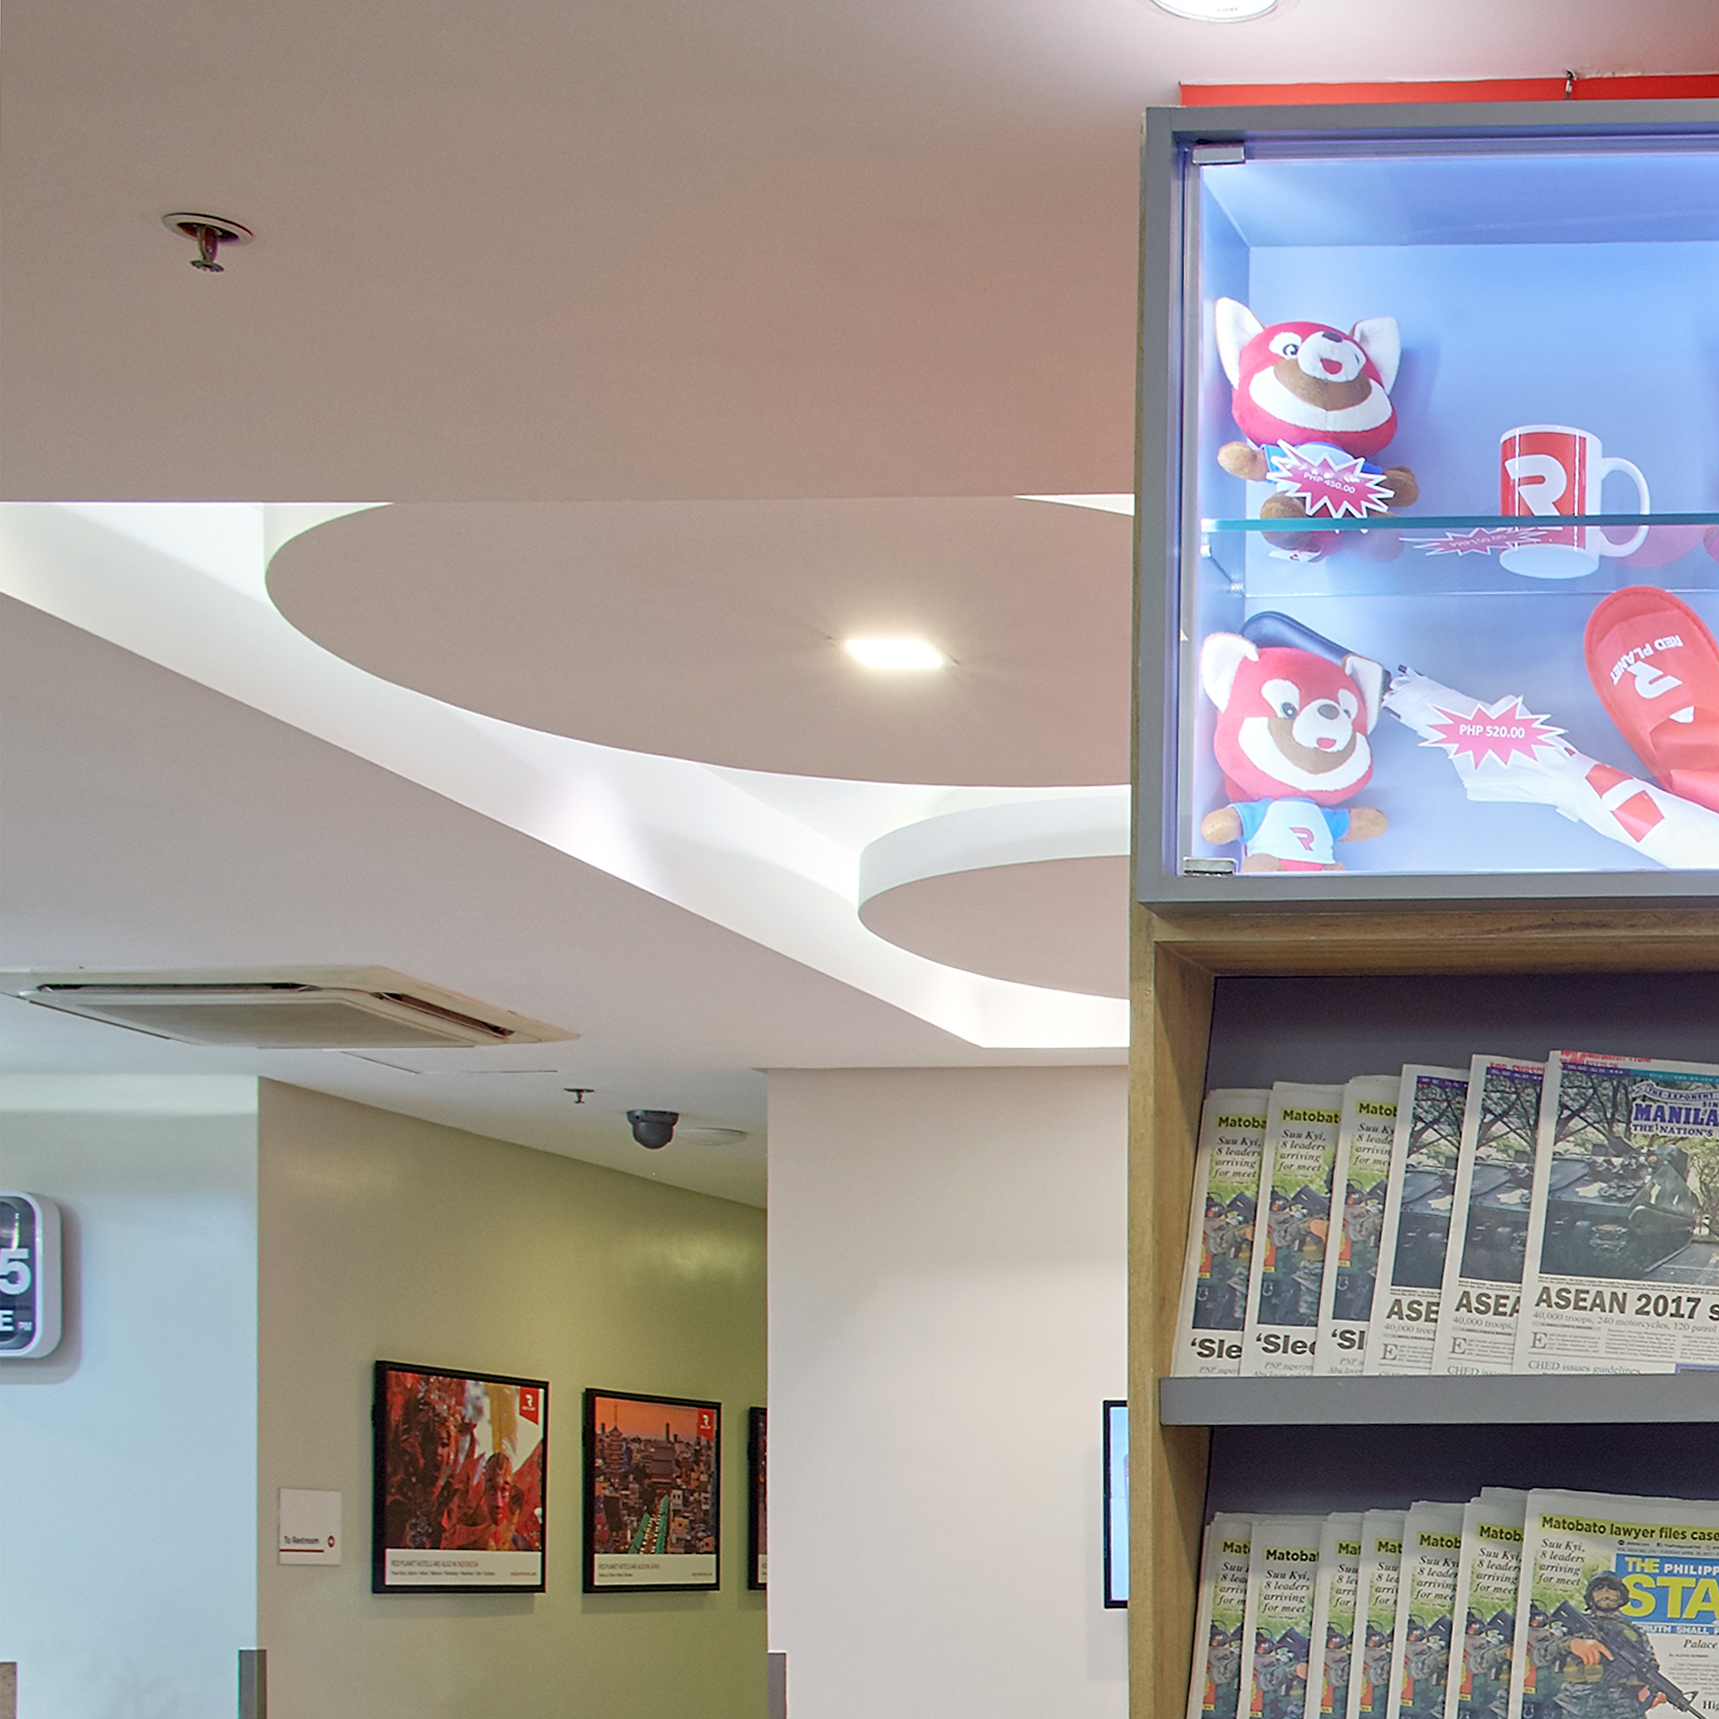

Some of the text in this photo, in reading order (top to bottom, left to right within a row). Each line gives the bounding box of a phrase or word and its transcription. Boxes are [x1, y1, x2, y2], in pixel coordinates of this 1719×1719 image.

[1459, 723, 1526, 740] PHP 520.00
[1534, 1286, 1628, 1314] ASEAN
[1634, 1293, 1702, 1319] 2017
[1541, 1516, 1606, 1535] Matobato
[1610, 1522, 1656, 1542] lawyer
[1659, 1525, 1687, 1540] files
[1625, 1556, 1660, 1573] THE
[1682, 1639, 1719, 1652] Palace
